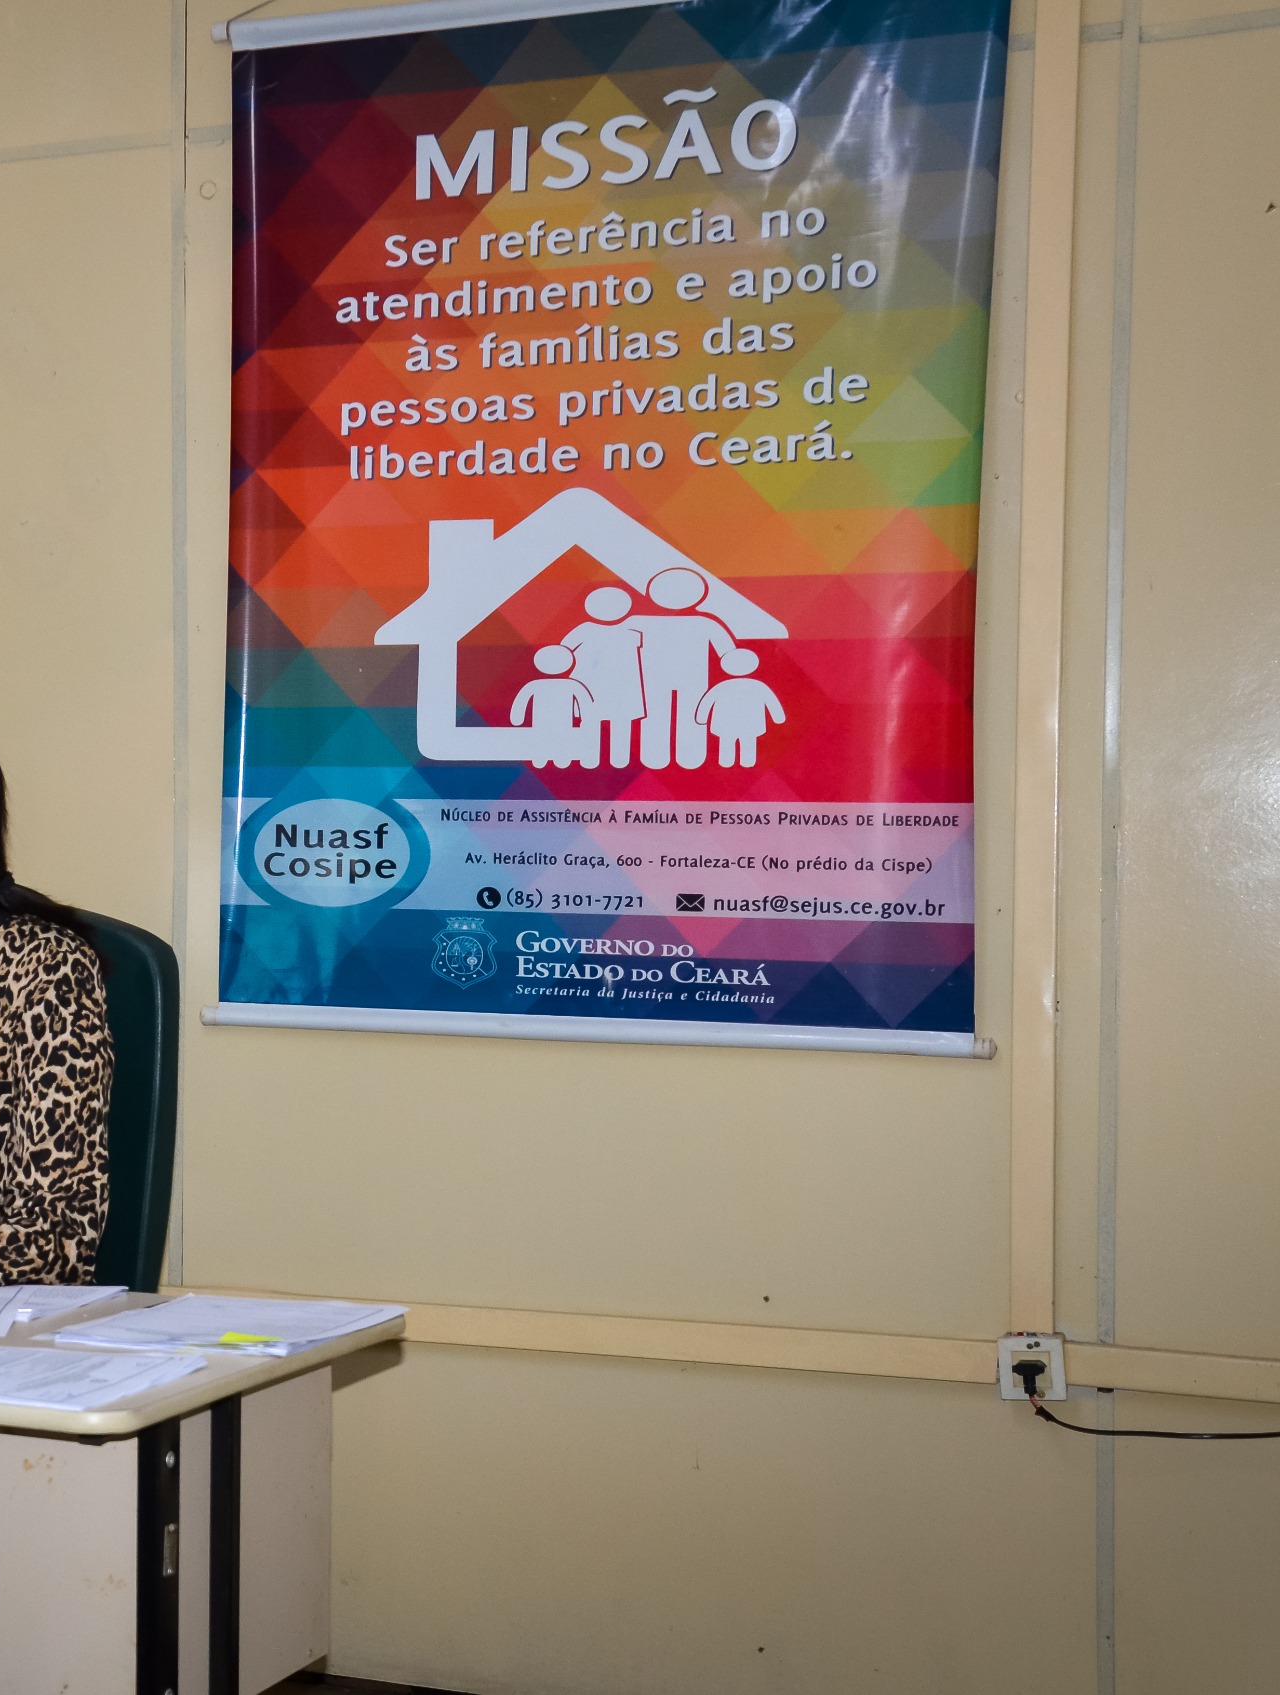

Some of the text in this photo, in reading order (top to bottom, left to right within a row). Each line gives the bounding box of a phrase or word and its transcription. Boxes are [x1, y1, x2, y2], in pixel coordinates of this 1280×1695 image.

[416, 86, 798, 200] MISSÃO
[385, 207, 826, 268] Ser referência no
[336, 253, 878, 324] atendimento e apoio
[405, 317, 795, 372] às famílias das
[341, 366, 869, 436] pessoas privadas de
[350, 419, 853, 480] liberdade no Ceará.
[440, 808, 959, 827] NÚCLEO DE ASSISTÊNCIA À FAMÍLIA DE PESSOAS PRIVADAS DE LIBERDADE
[275, 822, 389, 849] Nuasf
[263, 852, 397, 884] Cosipe
[465, 852, 487, 865] Av.
[493, 851, 558, 866] Heráclito
[564, 853, 610, 869] Graça,
[616, 854, 643, 868] 600
[660, 855, 756, 870] Fortaleza-CE
[761, 855, 789, 871] (No
[796, 856, 848, 873] prédio
[854, 858, 875, 871] da
[882, 857, 933, 875] Cispe)
[506, 888, 644, 911] (85) 3101-7721
[713, 895, 946, 919] nuasf@sejus.ce.gov.br
[515, 930, 694, 958] GOVERNO DO
[515, 955, 771, 986] ESTADO DO CEARÁ
[515, 984, 776, 1004] Secretaria da Justiça e Cidadania
